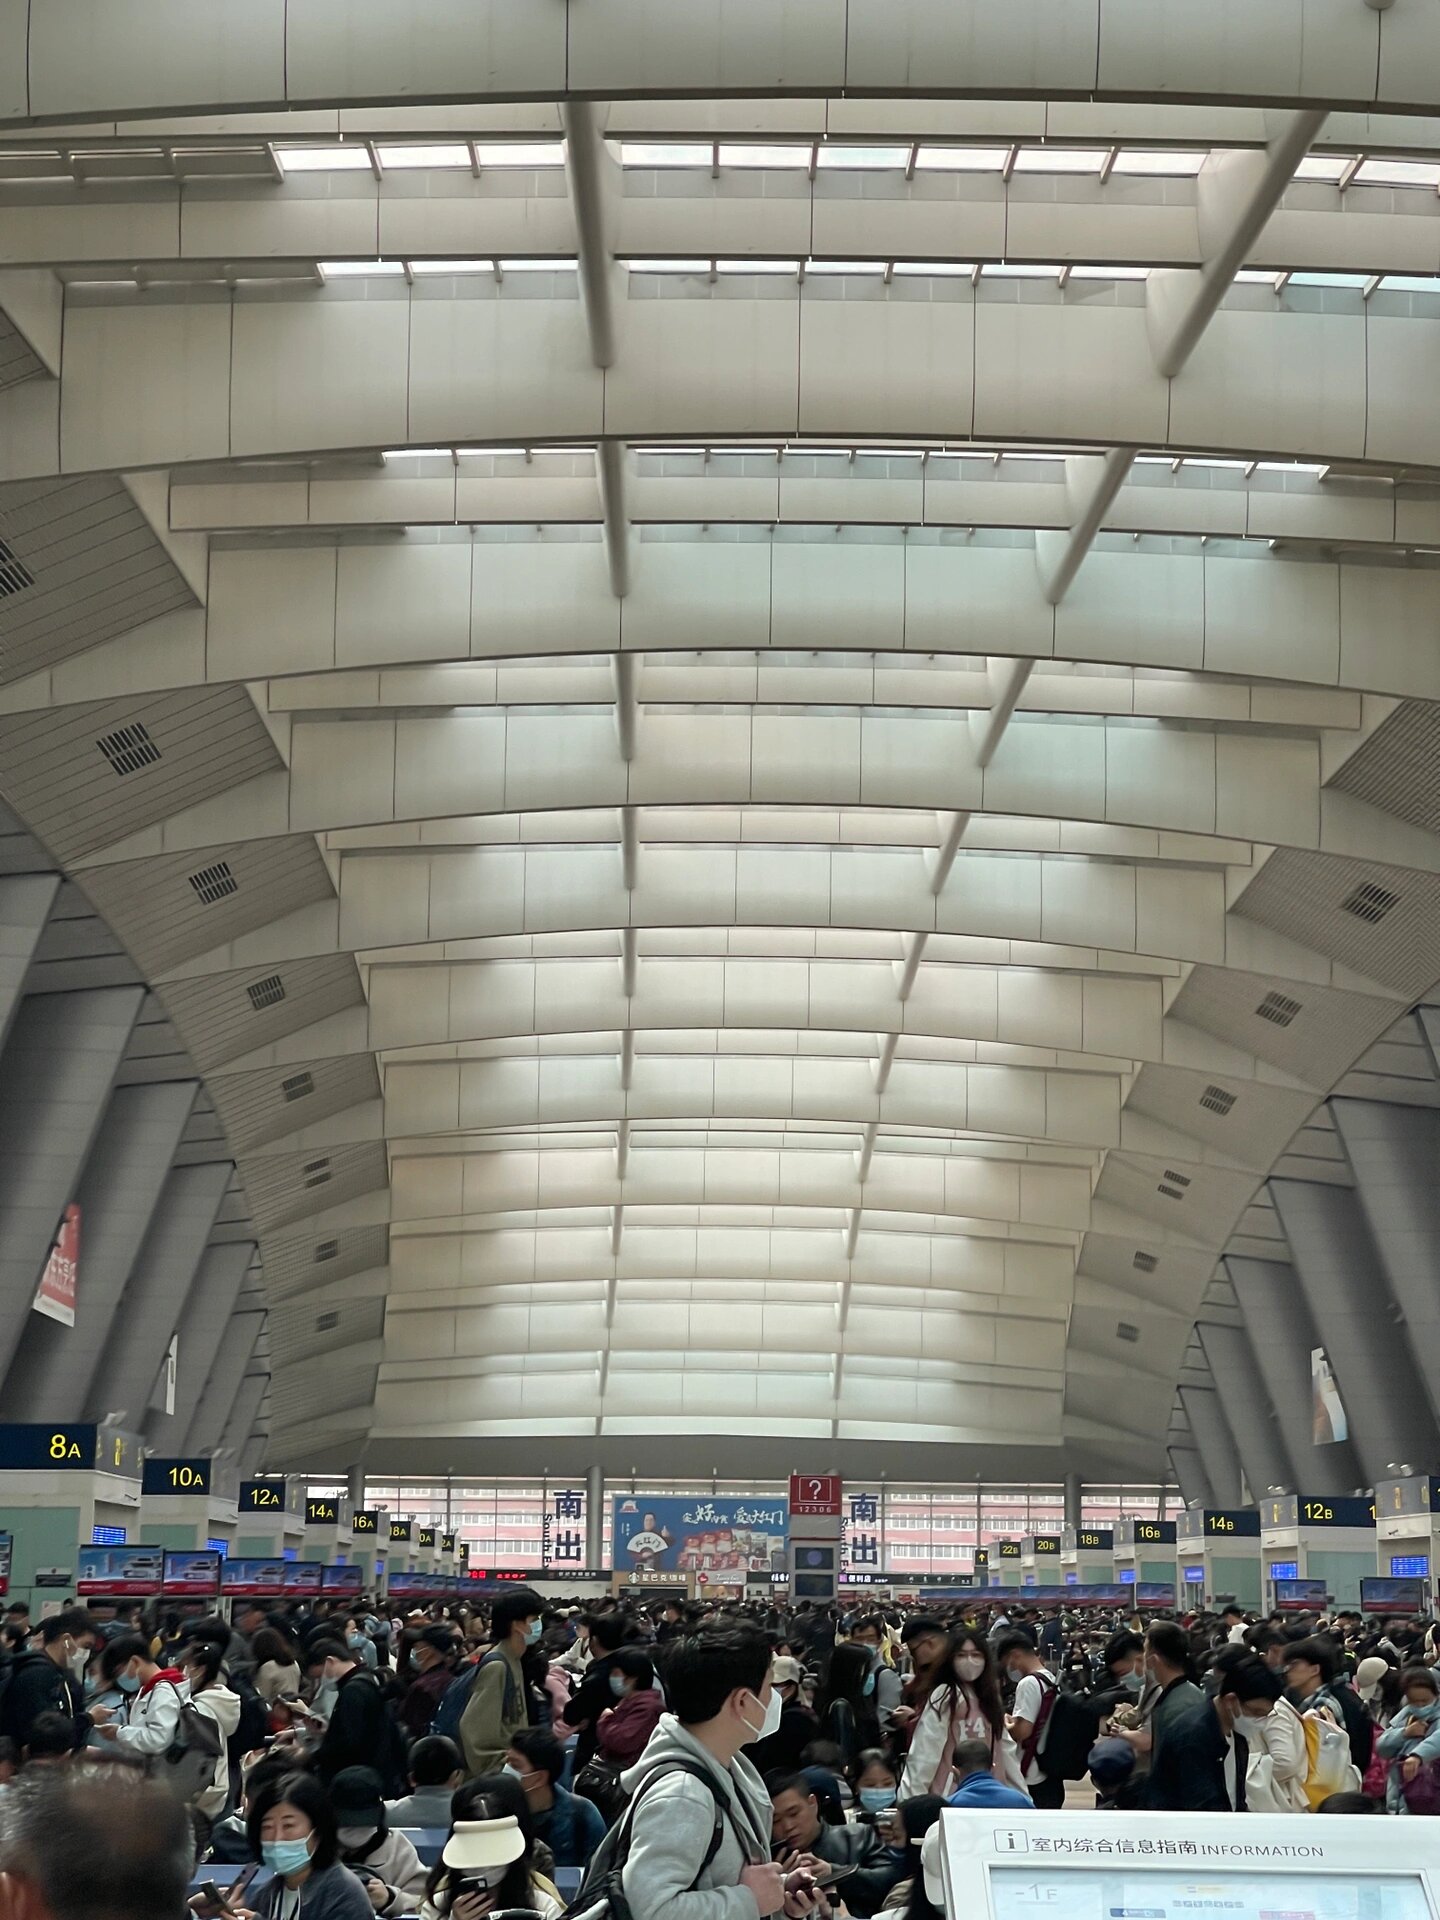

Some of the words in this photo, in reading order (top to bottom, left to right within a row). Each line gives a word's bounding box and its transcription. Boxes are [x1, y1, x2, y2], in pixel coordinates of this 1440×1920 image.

[50, 1434, 81, 1459] 8A
[168, 1467, 204, 1487] 10A
[250, 1488, 280, 1505] 12A
[310, 1505, 334, 1518] 14A
[799, 1506, 831, 1514] 12306
[1304, 1504, 1332, 1519] 12B
[353, 1516, 374, 1529] 16A
[1209, 1517, 1234, 1530] 14B
[419, 1534, 432, 1543] 0A
[1138, 1526, 1160, 1539] 16B
[1037, 1541, 1055, 1550] 20B
[1080, 1535, 1099, 1545] 18B
[1002, 1545, 1018, 1555] 22B
[1032, 1836, 1197, 1856] 室内综合信息指南
[1202, 1844, 1324, 1857] INFORMATION
